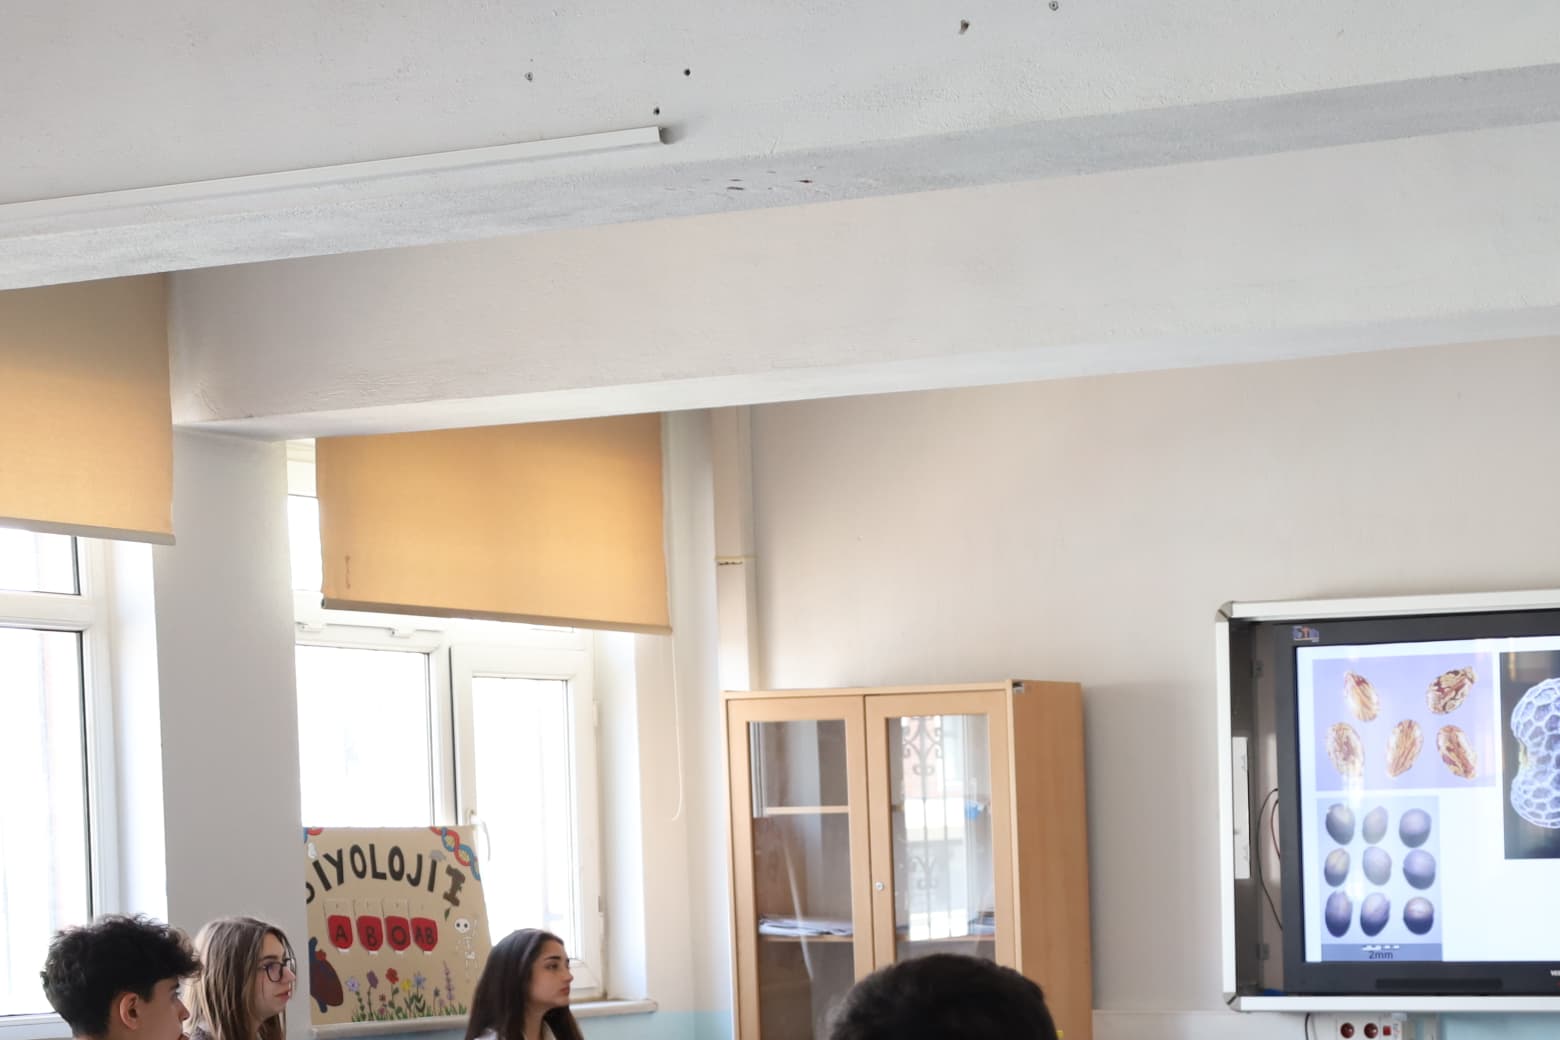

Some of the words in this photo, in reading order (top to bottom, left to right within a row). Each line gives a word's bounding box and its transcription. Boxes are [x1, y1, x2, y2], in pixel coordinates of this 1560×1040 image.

[335, 925, 348, 942] A
[366, 925, 378, 947] B
[415, 925, 435, 945] AB
[1369, 950, 1393, 960] 2mm
